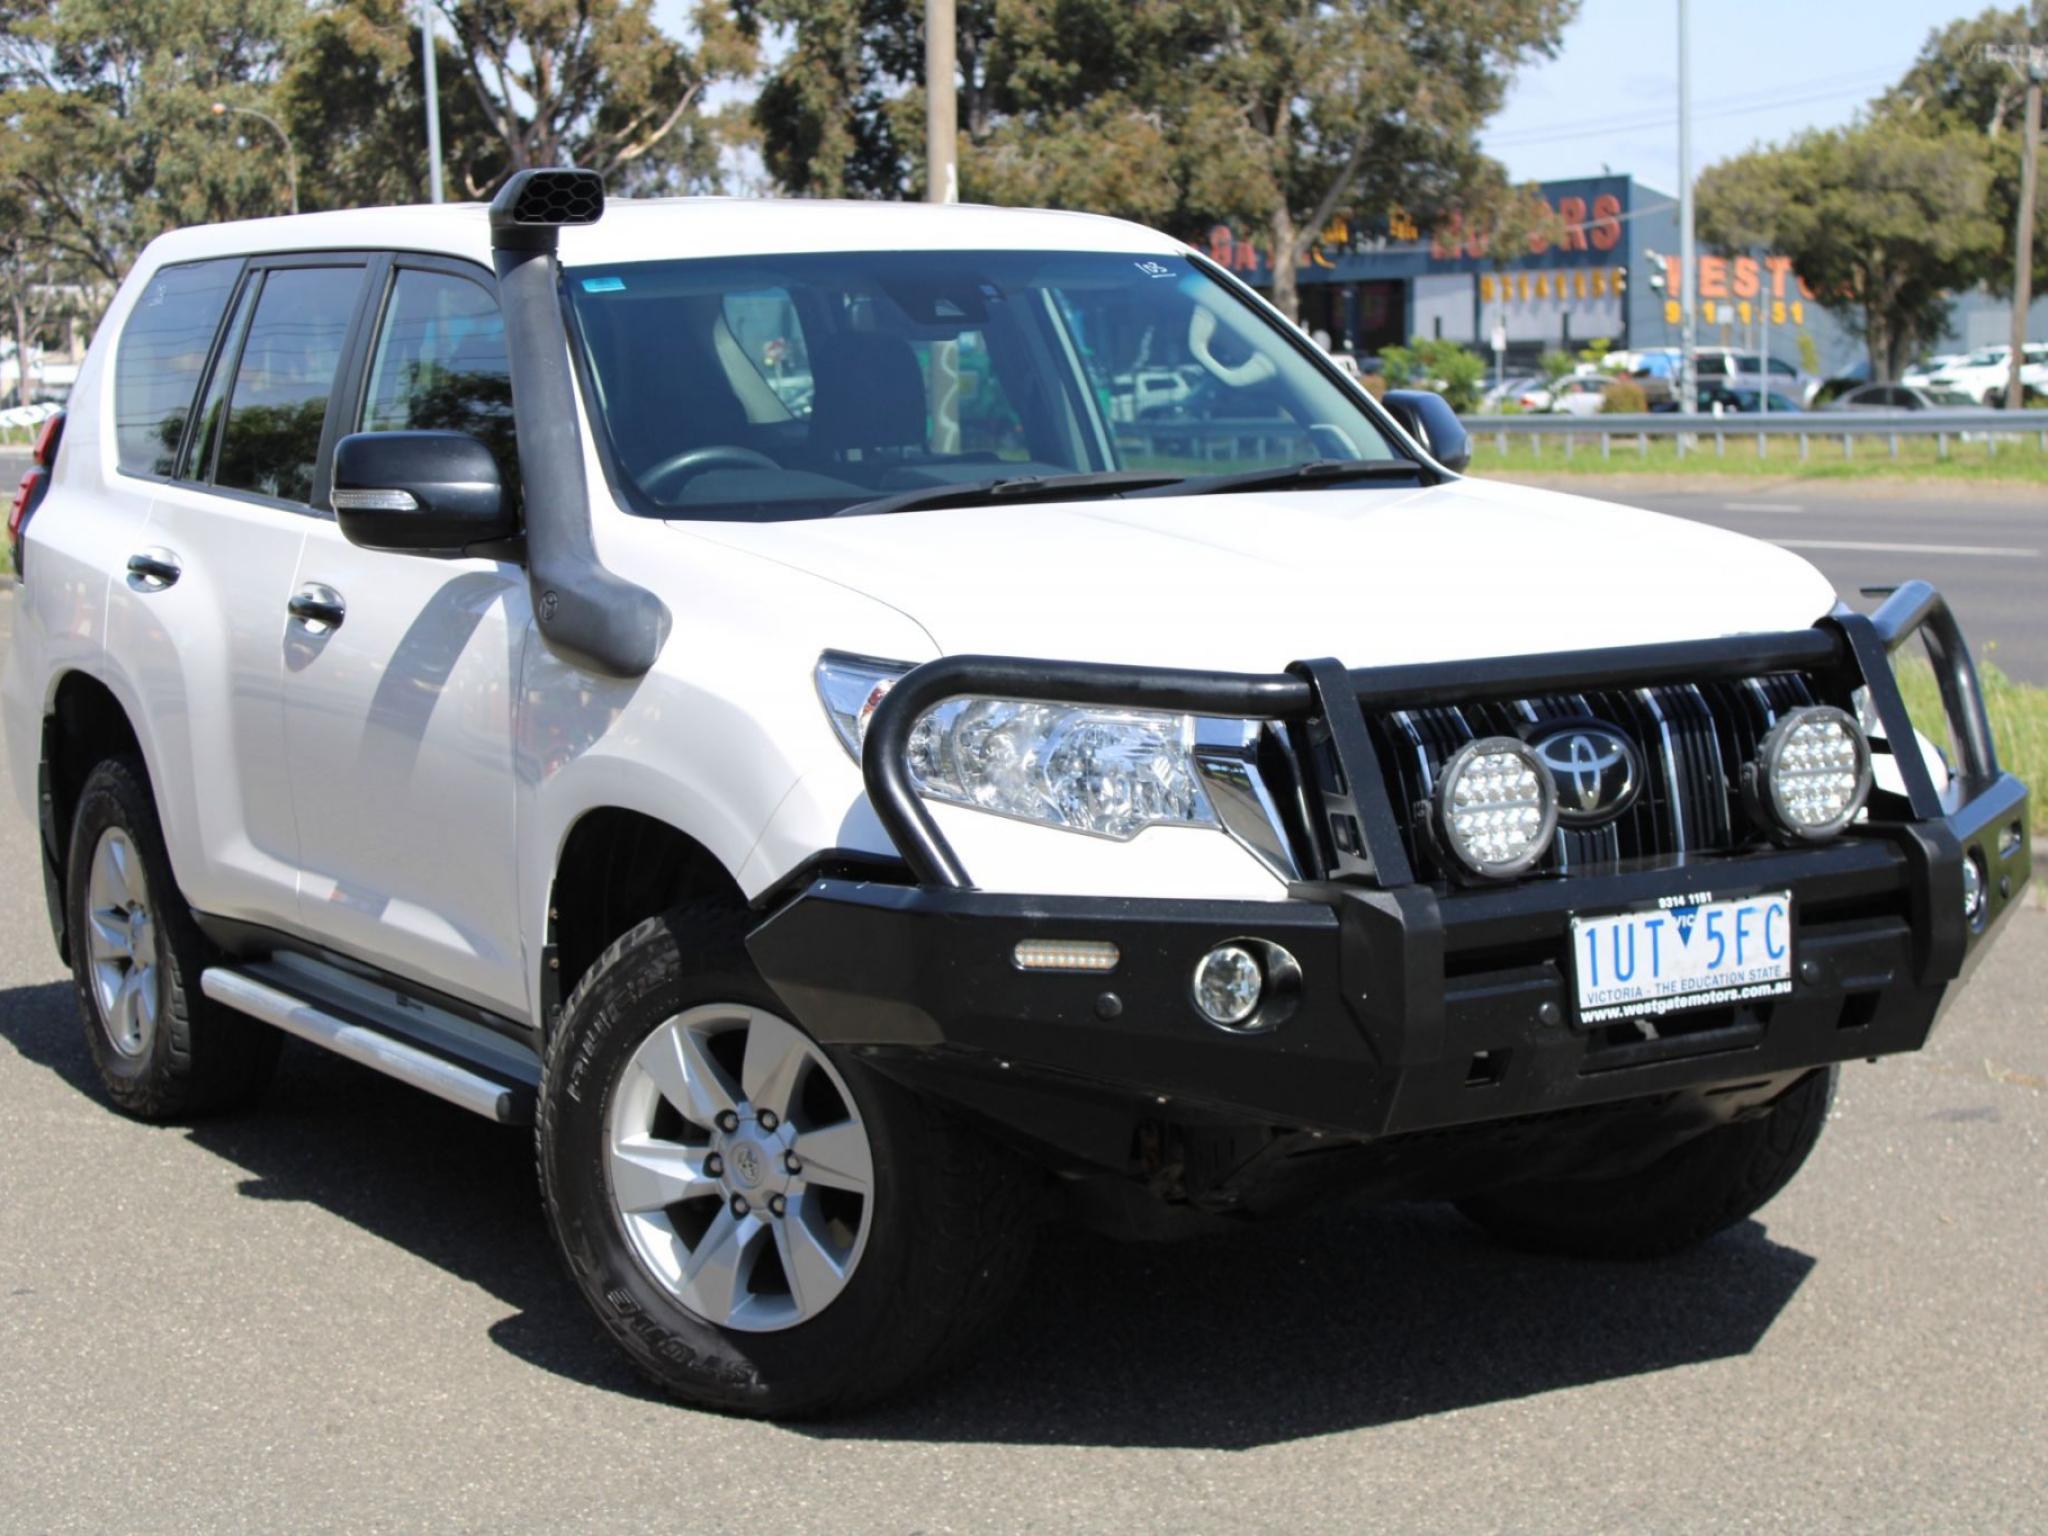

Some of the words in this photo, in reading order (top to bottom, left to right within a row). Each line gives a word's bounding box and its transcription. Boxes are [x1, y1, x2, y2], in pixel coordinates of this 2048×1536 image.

[1585, 918, 1664, 987] 1UT
[1706, 903, 1785, 970] 5FC
[1581, 981, 1793, 1024] www.westgatemotors.com.au
[1587, 987, 1643, 1004] VICTORIA
[1655, 980, 1677, 994] THE
[1680, 971, 1745, 990] EDUCATION
[1748, 965, 1782, 980] STATE
